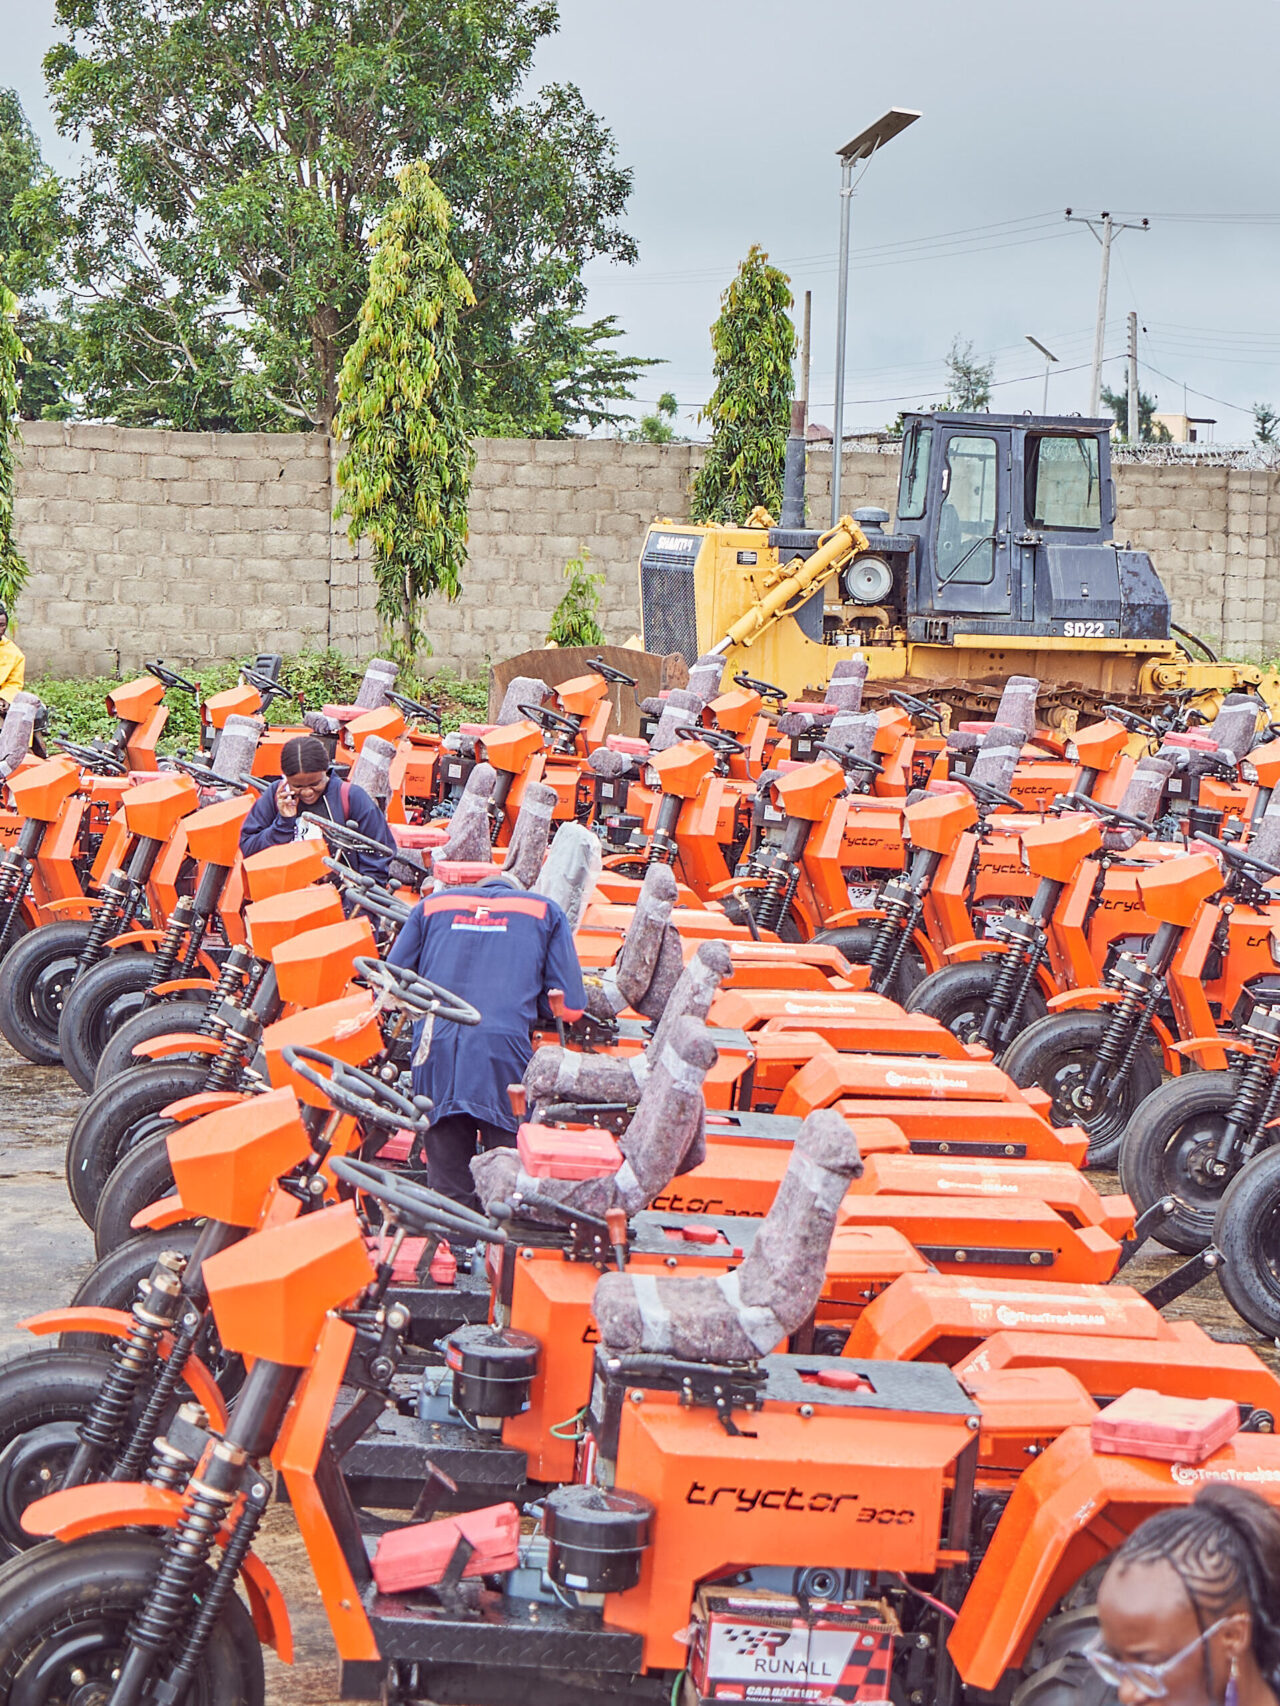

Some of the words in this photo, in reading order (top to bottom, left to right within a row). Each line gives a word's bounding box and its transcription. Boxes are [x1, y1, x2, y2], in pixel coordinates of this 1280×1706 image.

[1063, 621, 1105, 637] SD22
[686, 1481, 859, 1512] tryctor
[856, 1507, 915, 1525] 300
[754, 1658, 832, 1677] RUNALL
[746, 1686, 770, 1697] CAR
